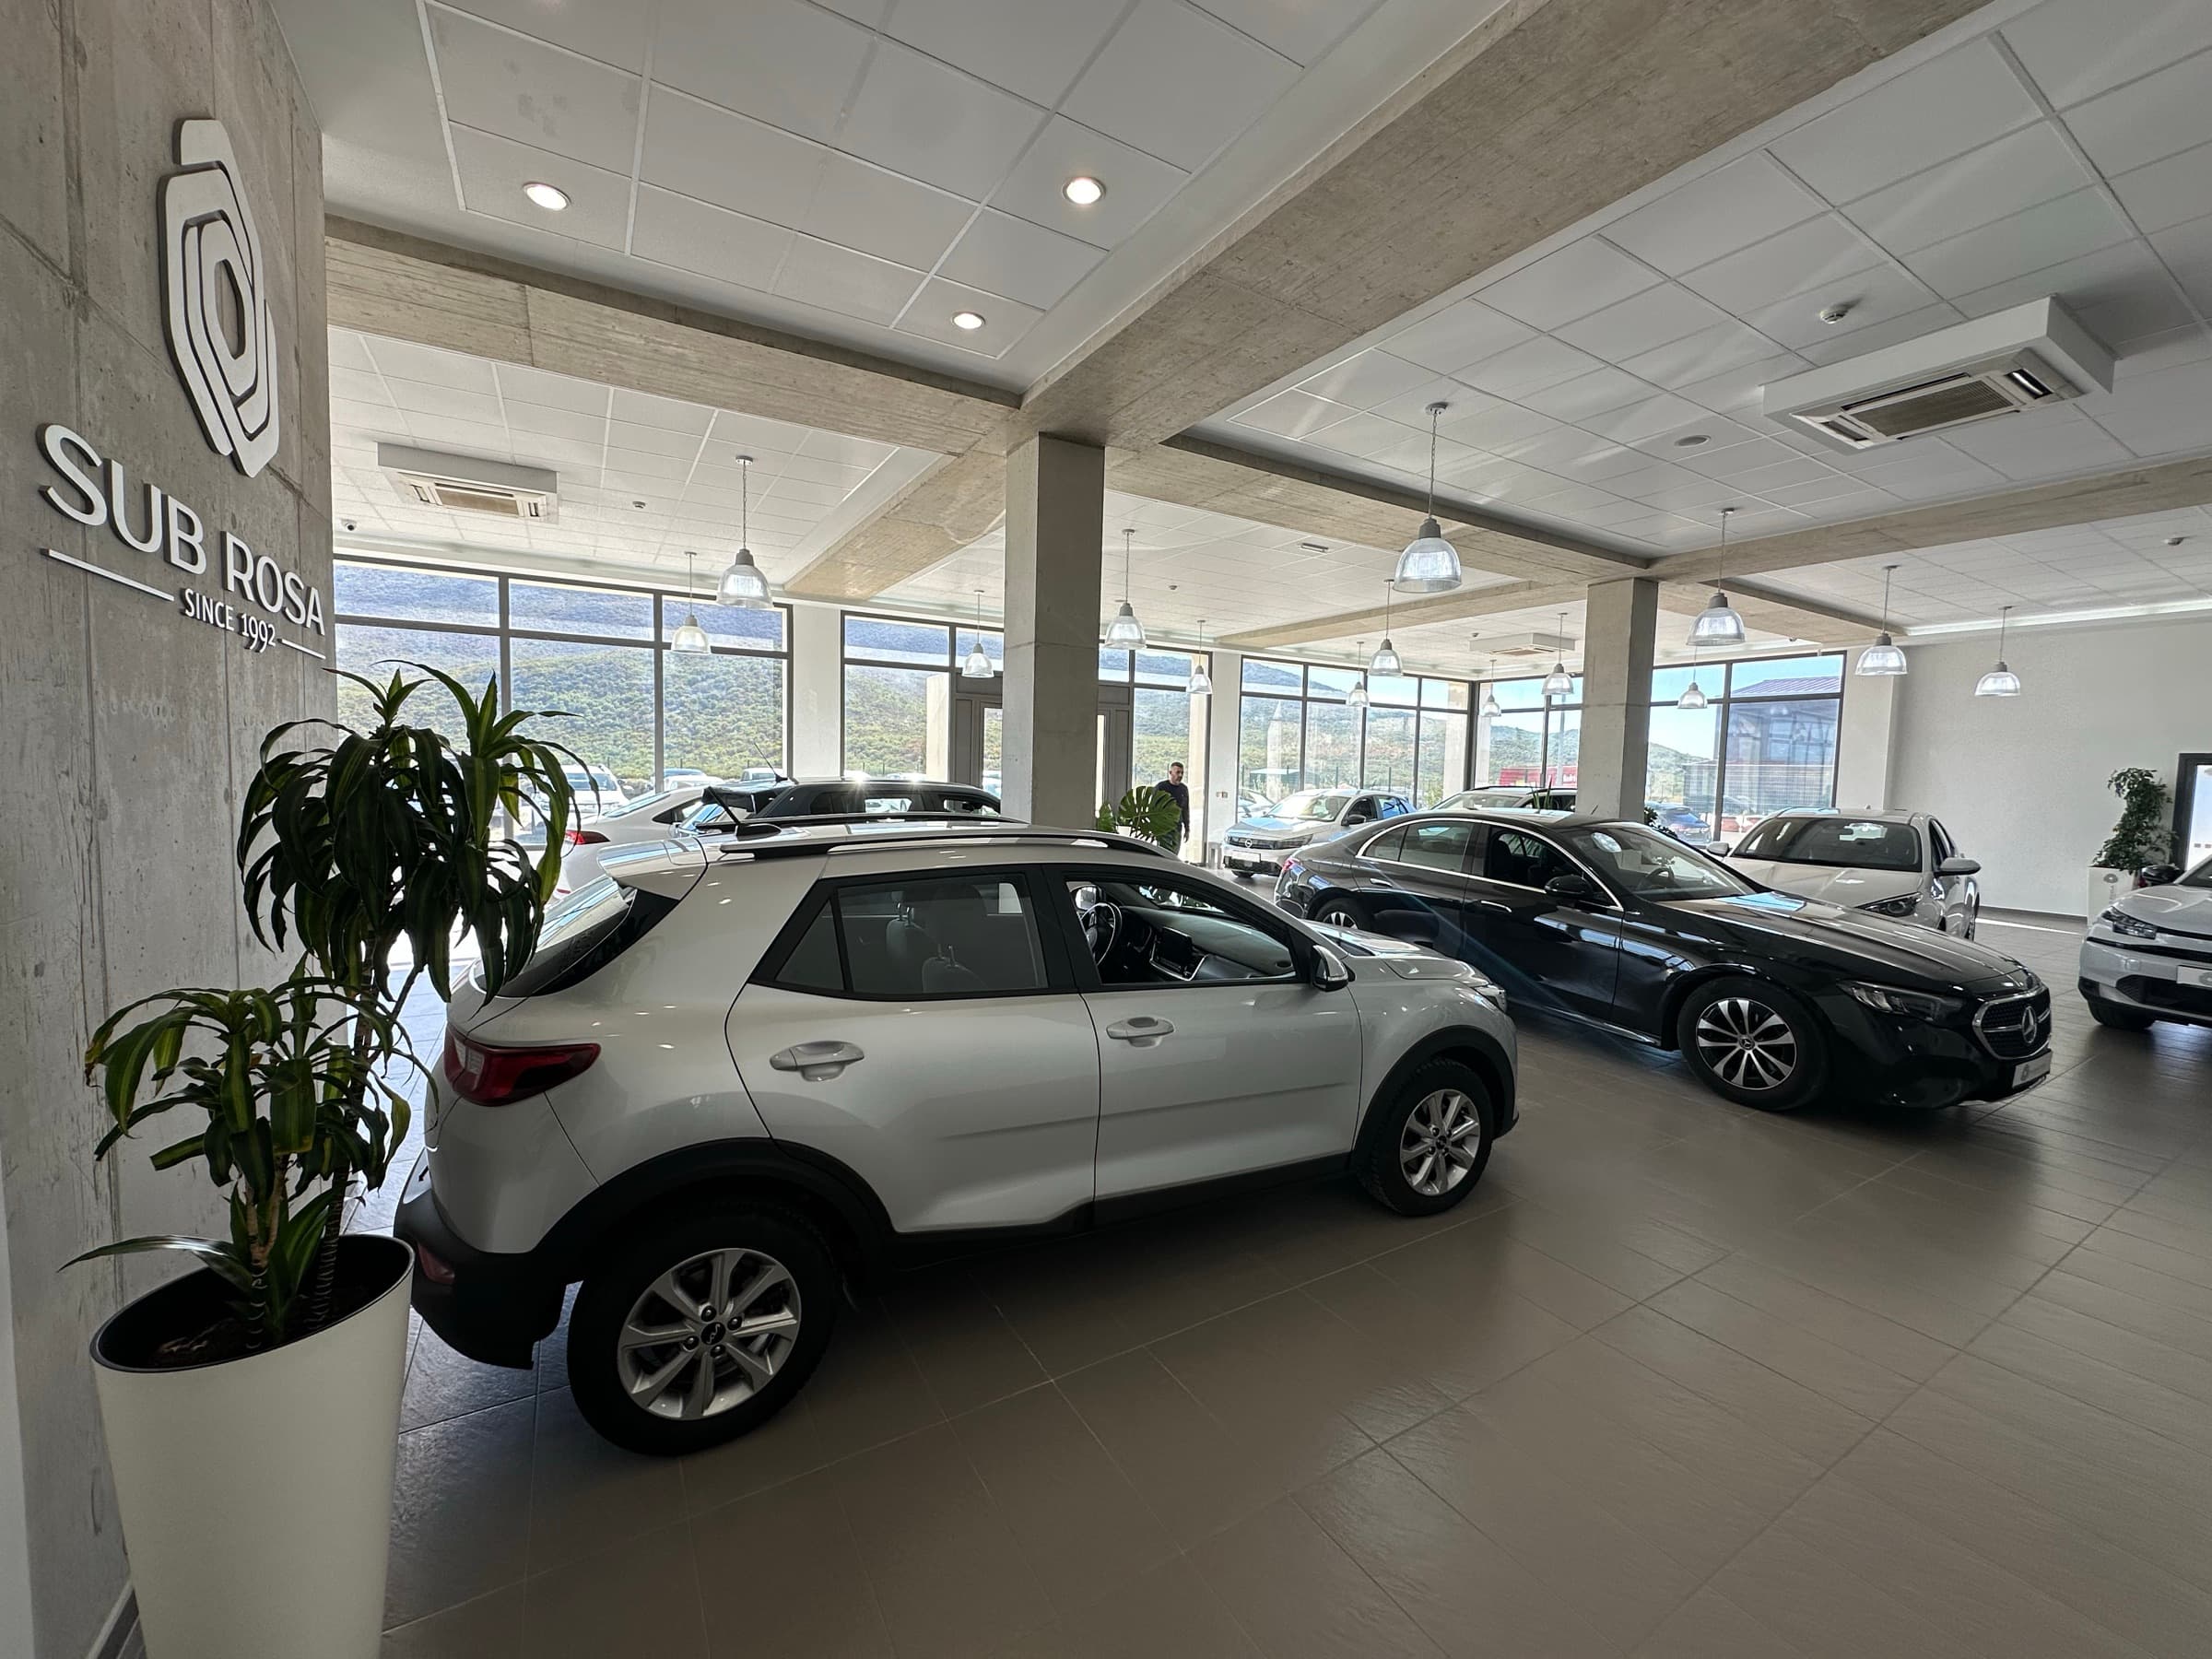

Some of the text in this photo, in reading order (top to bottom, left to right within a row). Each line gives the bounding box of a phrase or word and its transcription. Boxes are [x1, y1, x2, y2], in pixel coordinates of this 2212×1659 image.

[40, 424, 325, 636] SUB ROSA
[184, 588, 276, 653] SINCE 1992
